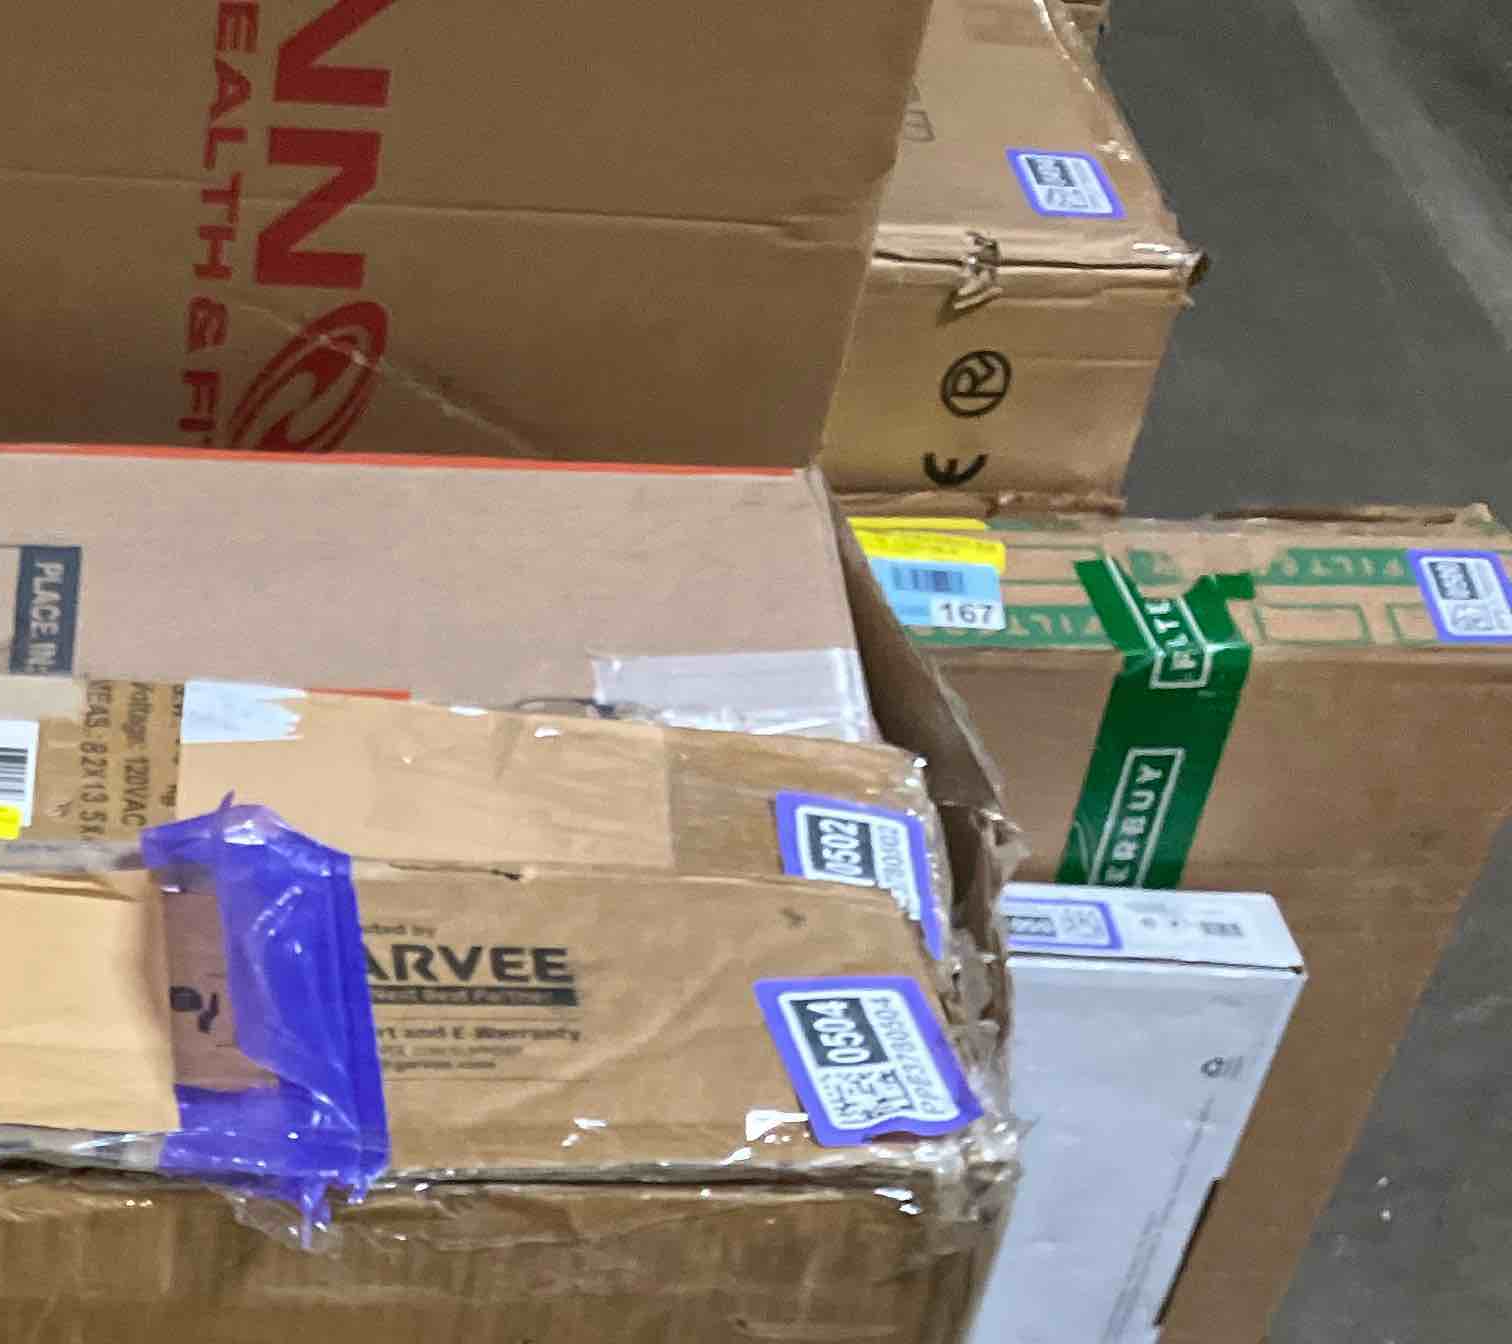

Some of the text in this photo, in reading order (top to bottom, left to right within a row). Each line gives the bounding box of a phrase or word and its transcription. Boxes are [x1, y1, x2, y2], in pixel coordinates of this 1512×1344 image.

[192, 0, 260, 280] EALTH
[176, 370, 222, 449] FI
[29, 560, 65, 639] PLACE
[941, 602, 994, 625] 167
[819, 817, 863, 878] 0502
[364, 943, 576, 983] ARVEE
[807, 1000, 872, 1065] 0504
